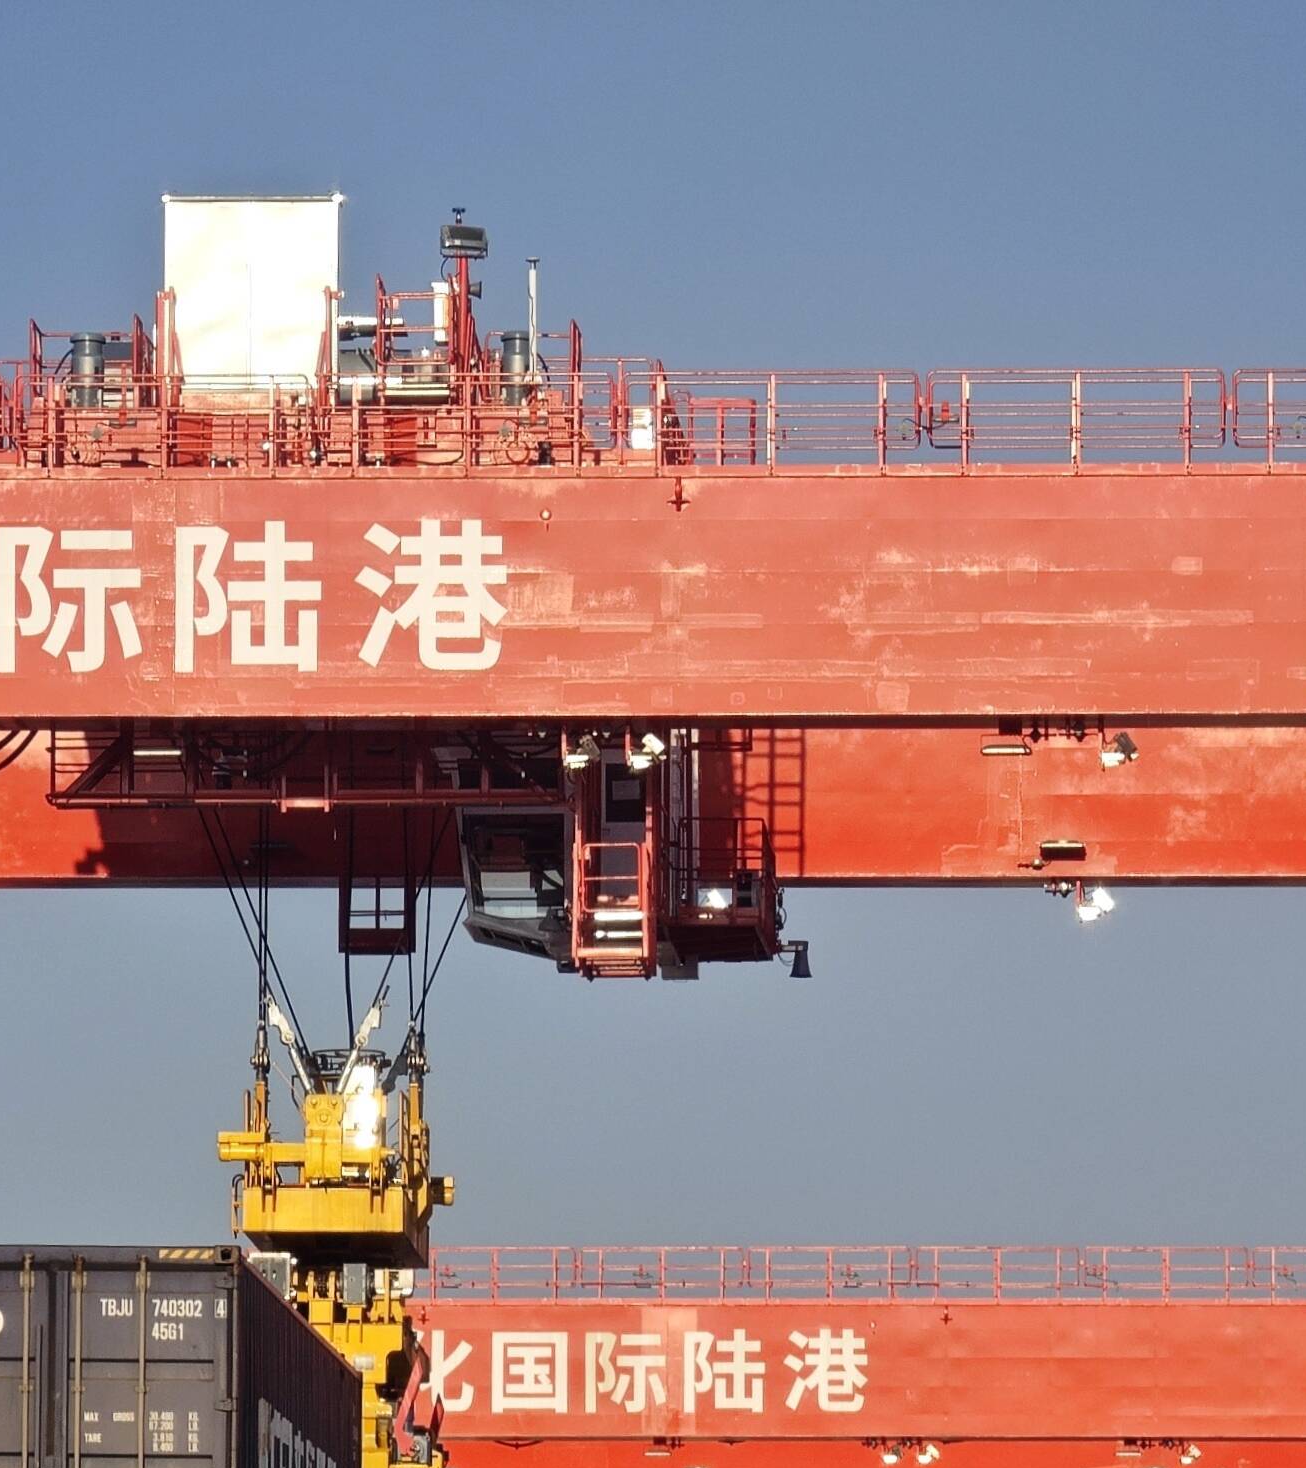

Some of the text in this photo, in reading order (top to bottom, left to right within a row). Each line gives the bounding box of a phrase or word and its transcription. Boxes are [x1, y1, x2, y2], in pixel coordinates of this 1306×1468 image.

[100, 1299, 226, 1318] TBJU 740302 4
[152, 1323, 184, 1341] 45G1
